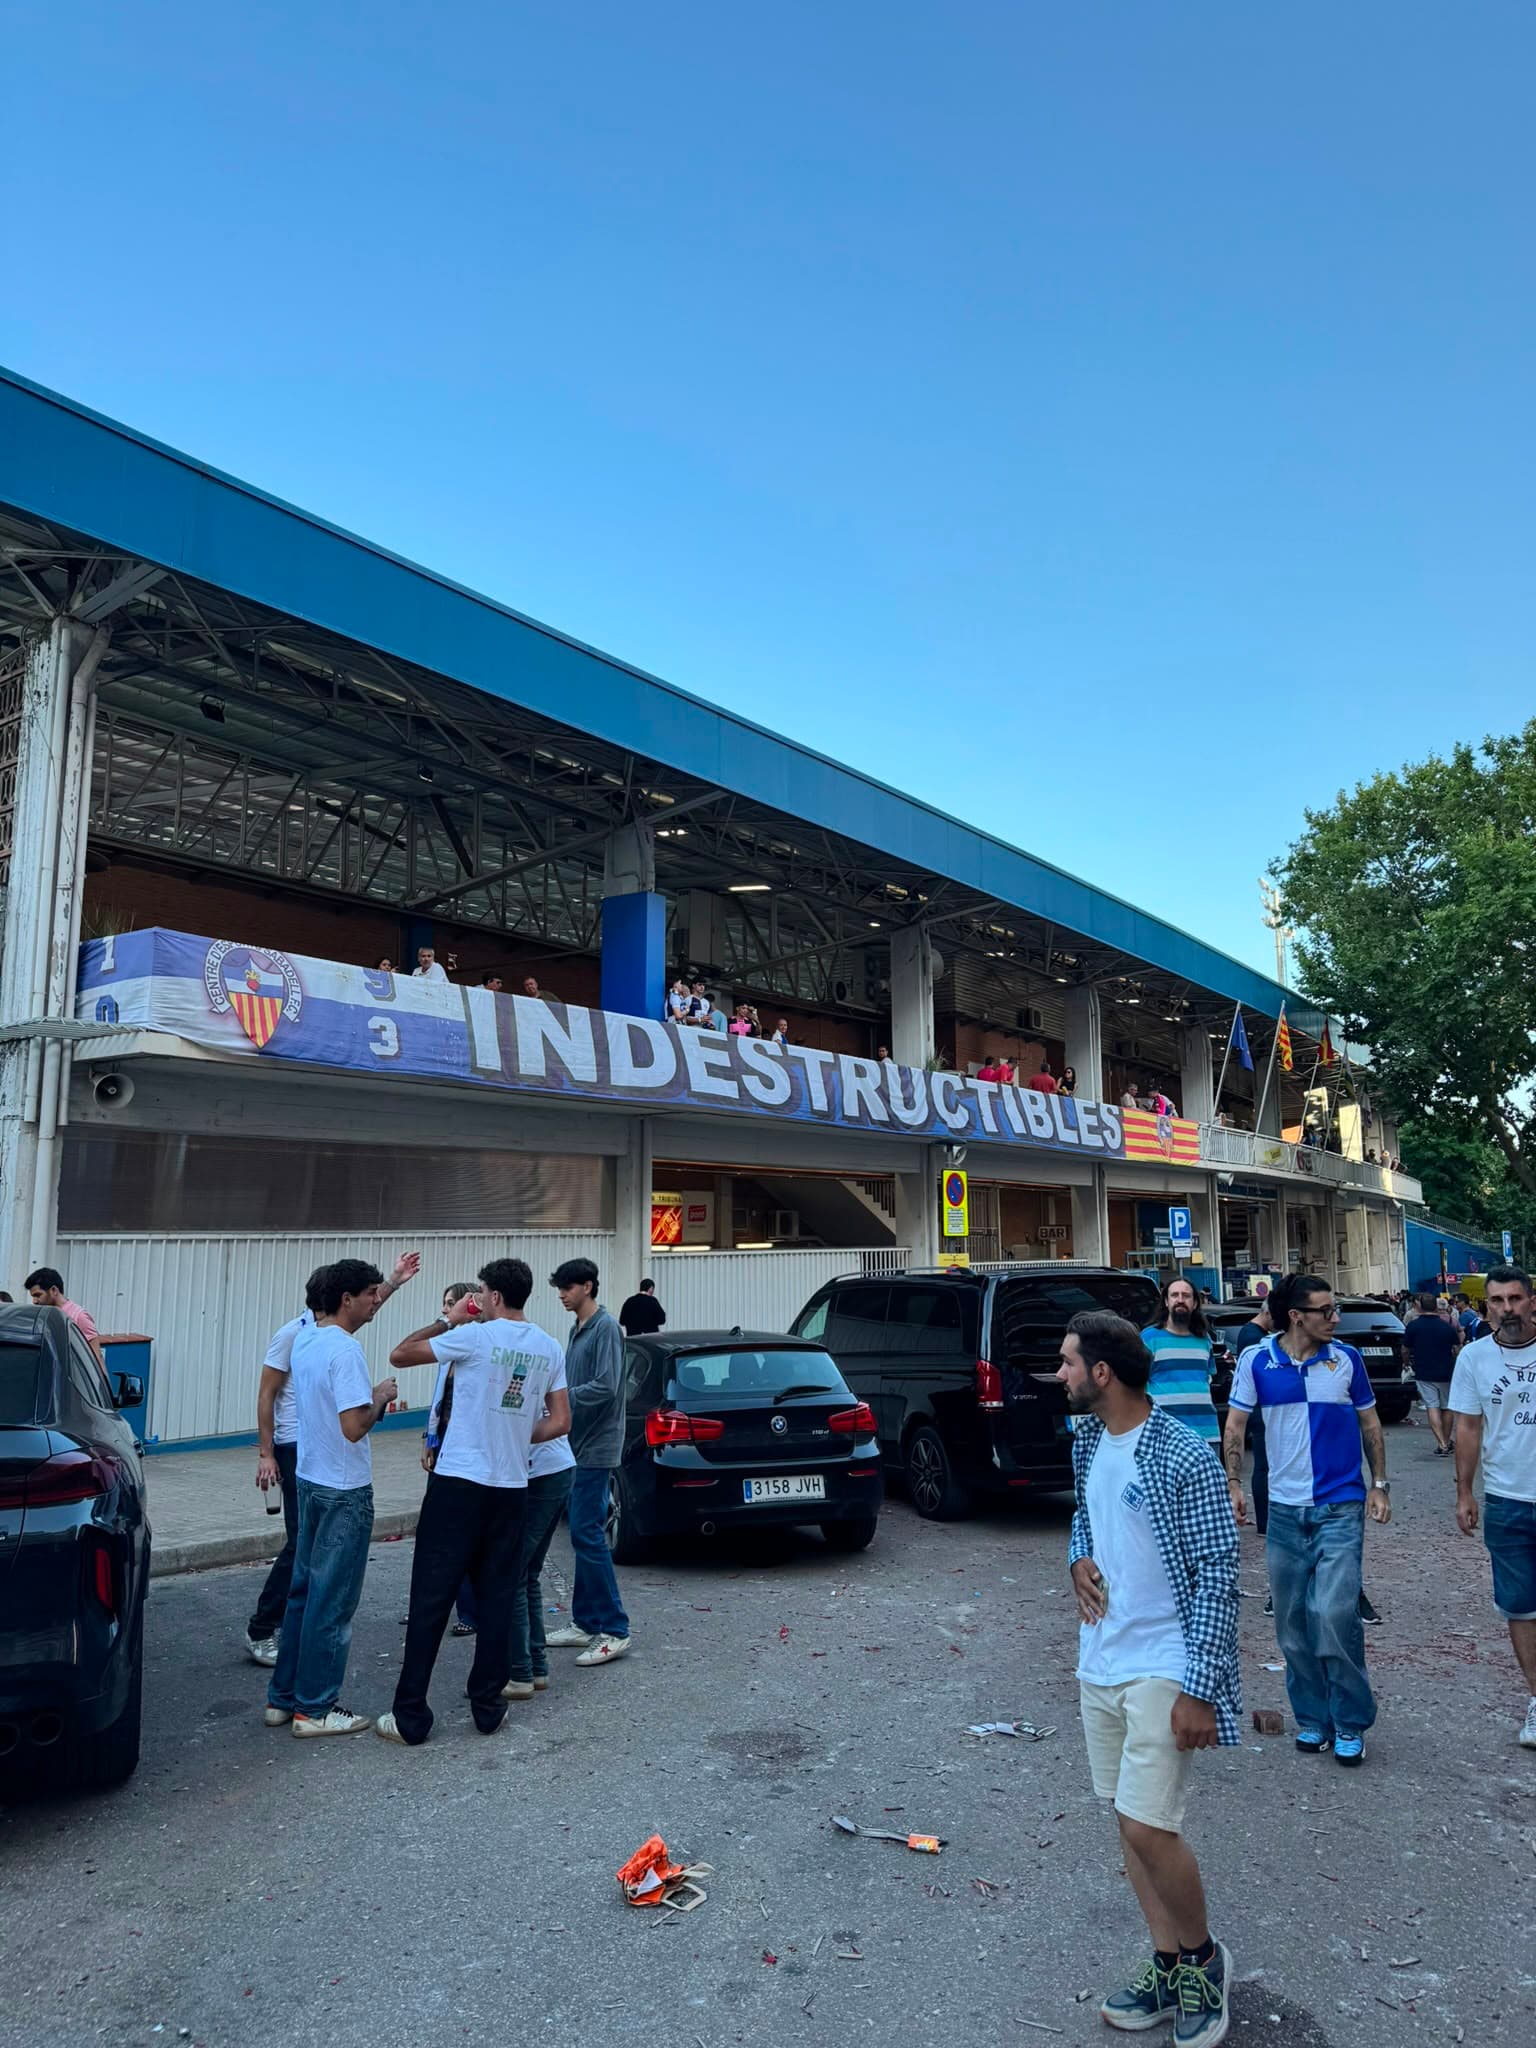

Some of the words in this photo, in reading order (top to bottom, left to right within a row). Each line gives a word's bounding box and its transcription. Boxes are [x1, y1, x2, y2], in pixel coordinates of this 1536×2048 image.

[207, 958, 225, 1006] CENTRE
[263, 949, 301, 996] SABADELL
[368, 1016, 399, 1056] 3
[465, 985, 1122, 1150] INDESTRUCTIBLES
[1039, 1227, 1065, 1239] BAR
[1174, 1211, 1187, 1236] P
[754, 1480, 790, 1496] 3158
[796, 1477, 821, 1493] JVH
